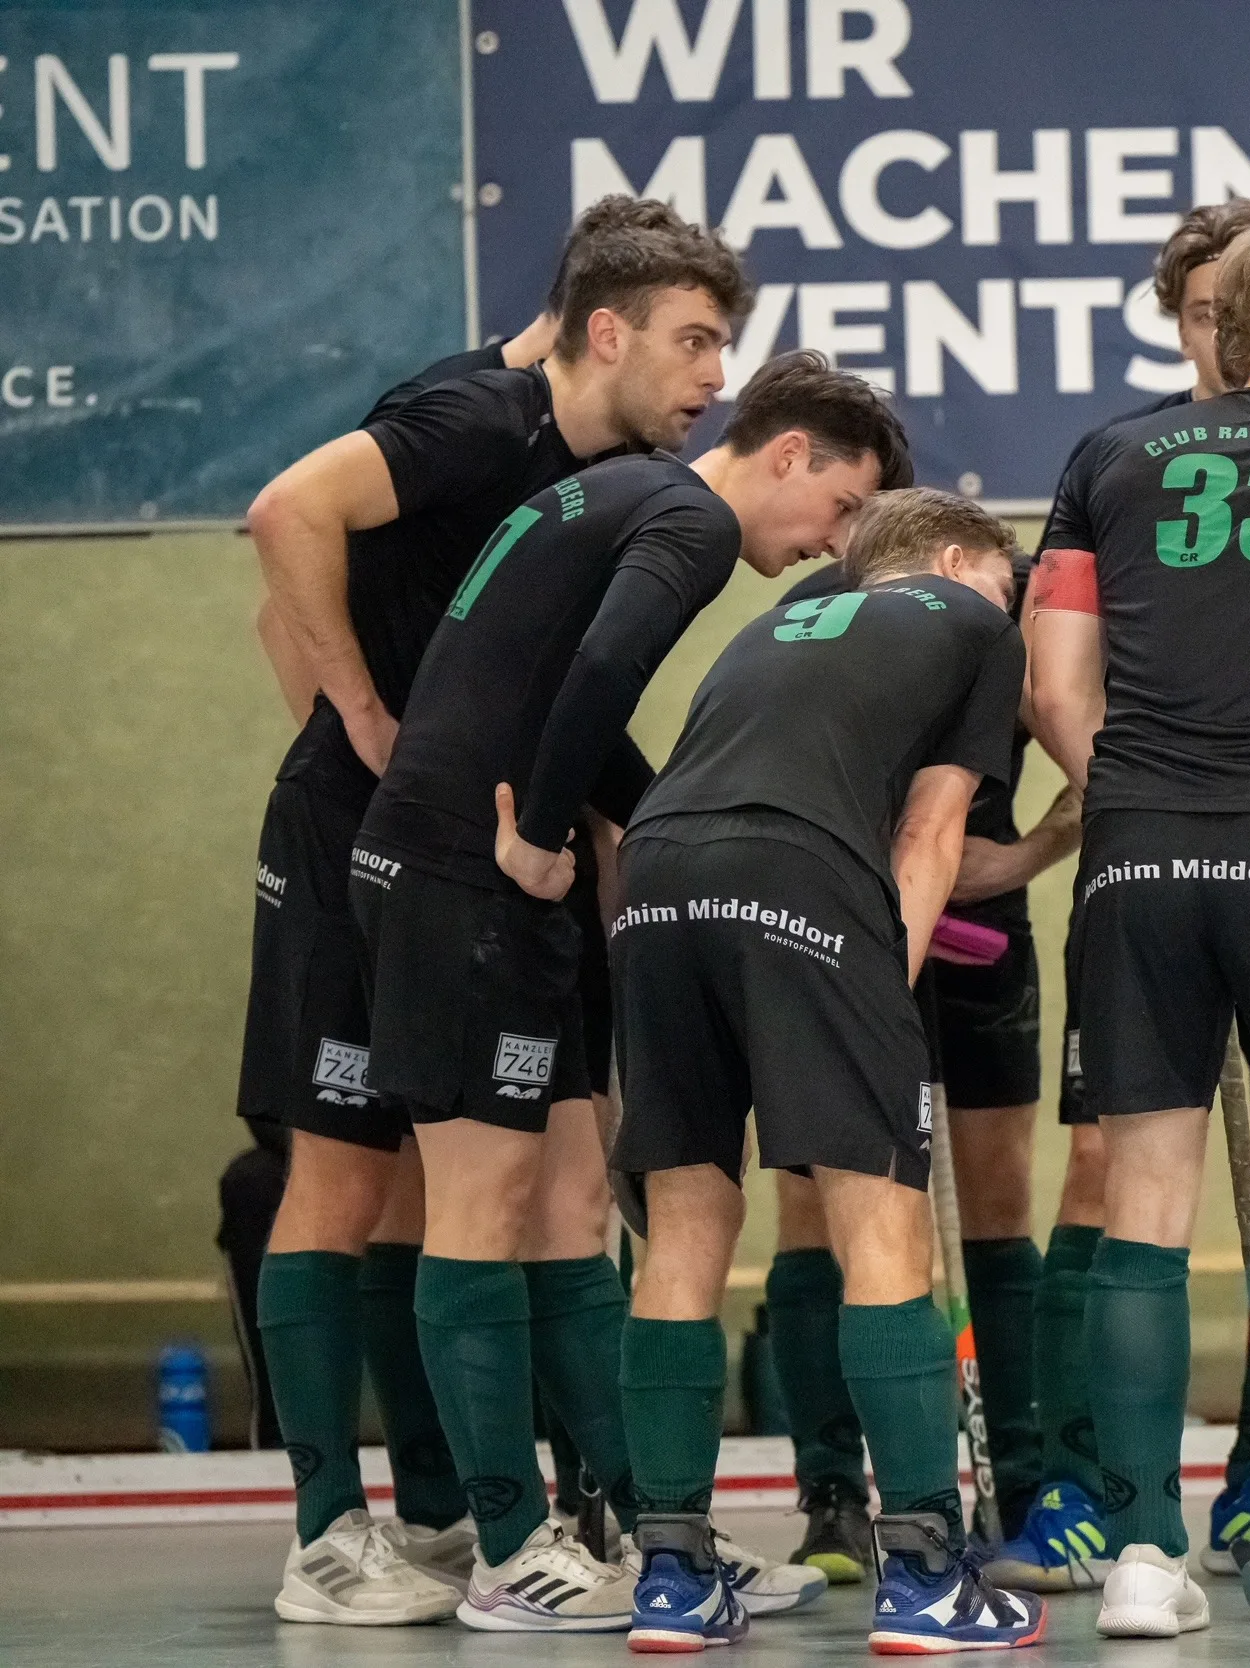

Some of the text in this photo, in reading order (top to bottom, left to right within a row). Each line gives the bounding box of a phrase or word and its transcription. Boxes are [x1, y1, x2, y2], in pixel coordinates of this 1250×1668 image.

[565, 0, 914, 104] WIR
[0, 53, 240, 171] NT
[0, 194, 219, 244] SATION
[718, 277, 1199, 400] VENTS
[1144, 427, 1208, 457] CLUB
[1180, 552, 1199, 562] CR
[774, 592, 869, 642] 9
[688, 898, 844, 954] Middeldorf
[763, 932, 841, 969] ROHSTOFFHANDEL
[503, 1052, 549, 1078] 746
